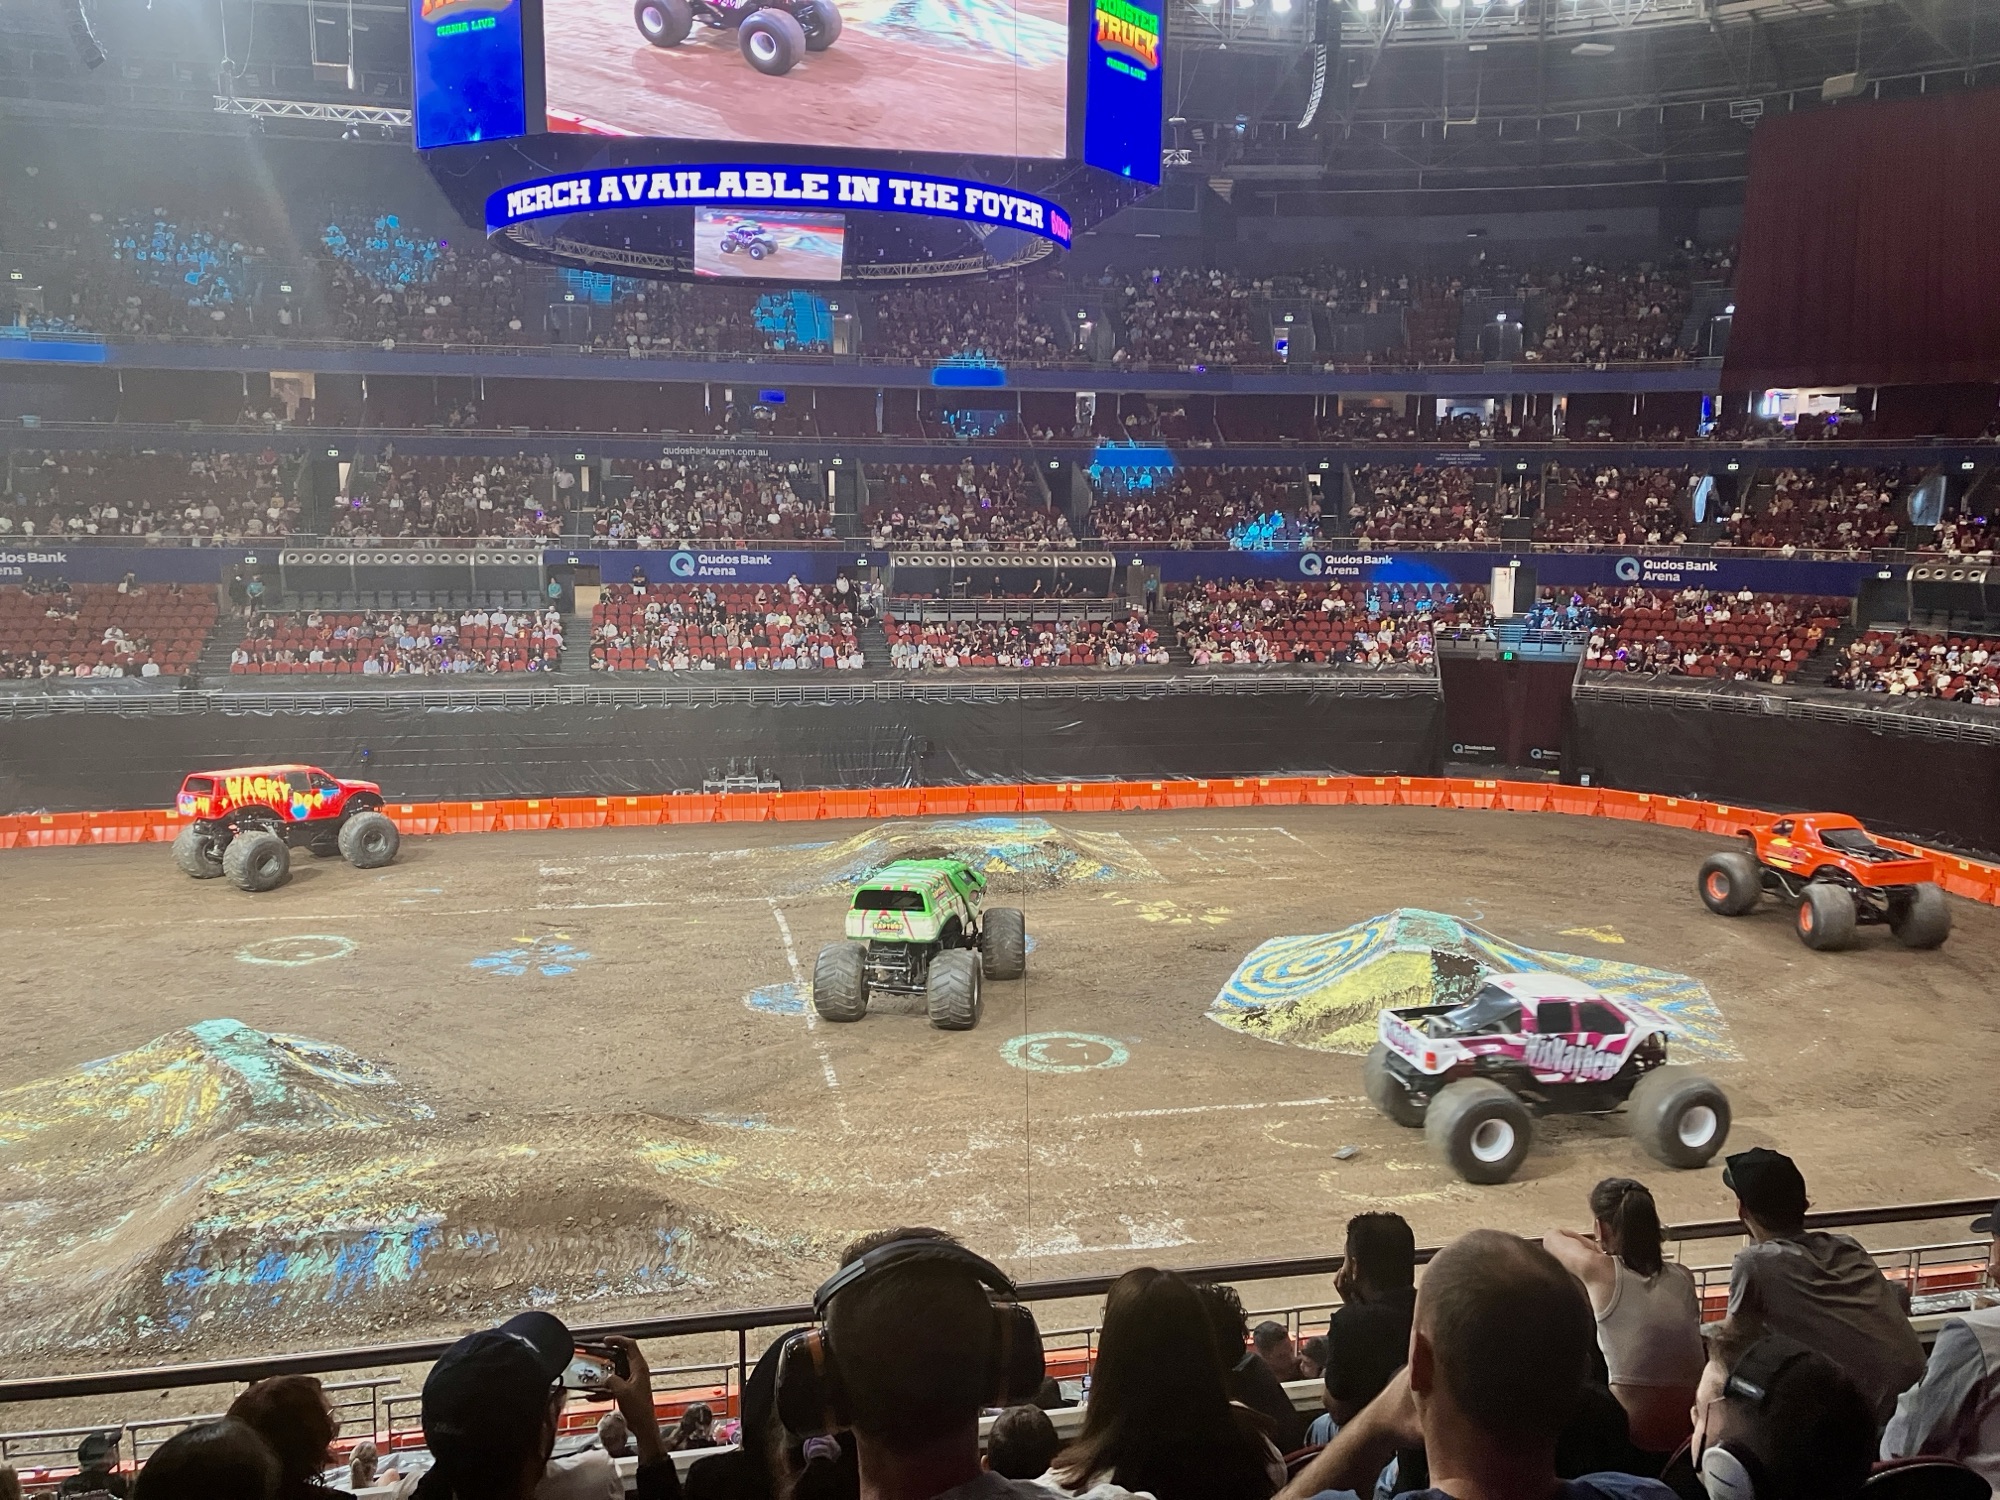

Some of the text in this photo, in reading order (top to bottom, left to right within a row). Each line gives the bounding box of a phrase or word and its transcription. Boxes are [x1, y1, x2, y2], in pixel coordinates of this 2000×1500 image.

[471, 17, 496, 31] LIVE
[1096, 8, 1158, 66] TRUCK
[507, 178, 591, 218] MERCH
[598, 171, 829, 203] AVAILABLE
[838, 174, 880, 203] IN
[888, 178, 959, 211] THE
[965, 187, 1044, 229] FOYER
[27, 552, 67, 563] Bank
[698, 554, 772, 565] Qudos Bank
[1324, 554, 1393, 565] Qudos Bank
[698, 565, 736, 576] Arena
[1324, 565, 1359, 575] Arena
[1643, 559, 1718, 572] Qudos Bank
[1642, 571, 1681, 581] Arena
[225, 775, 291, 808] WACKY
